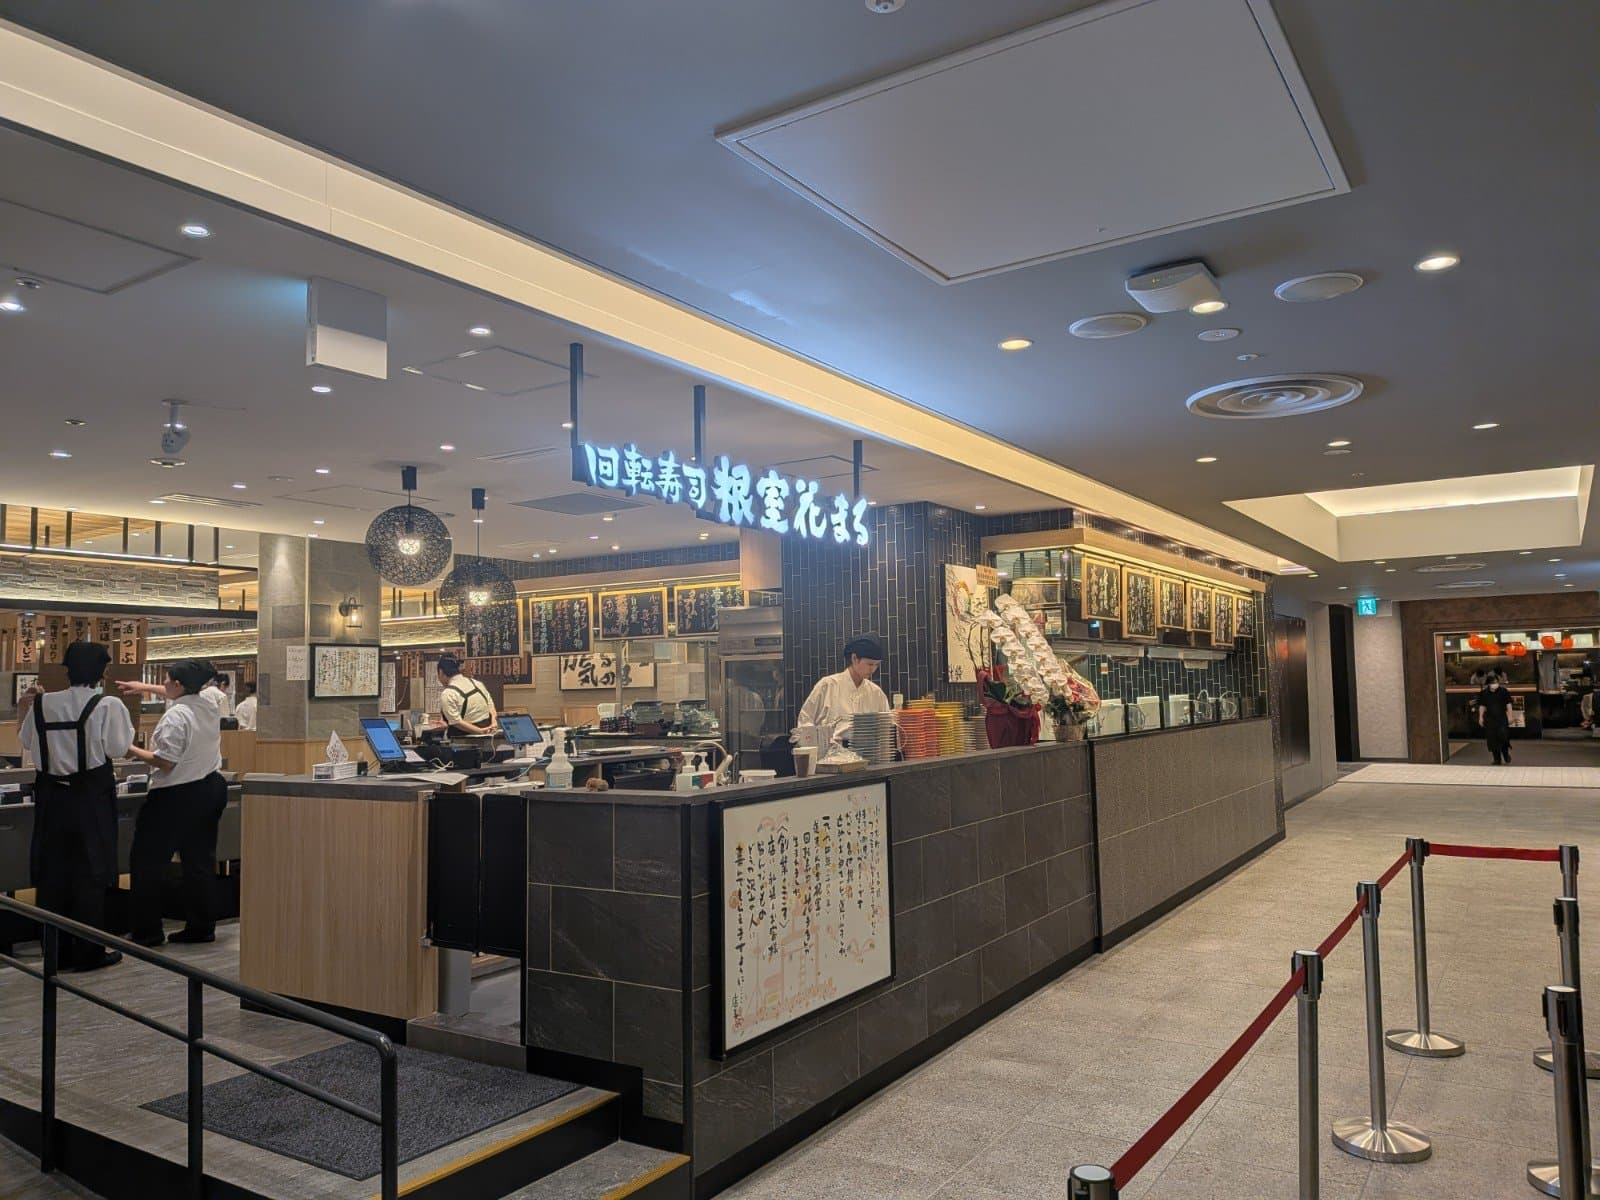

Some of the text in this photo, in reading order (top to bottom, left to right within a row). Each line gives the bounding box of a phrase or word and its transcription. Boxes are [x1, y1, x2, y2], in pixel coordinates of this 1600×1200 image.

[584, 442, 869, 546] 回転寿司 根室花まる
[121, 623, 134, 663] 活つぶ
